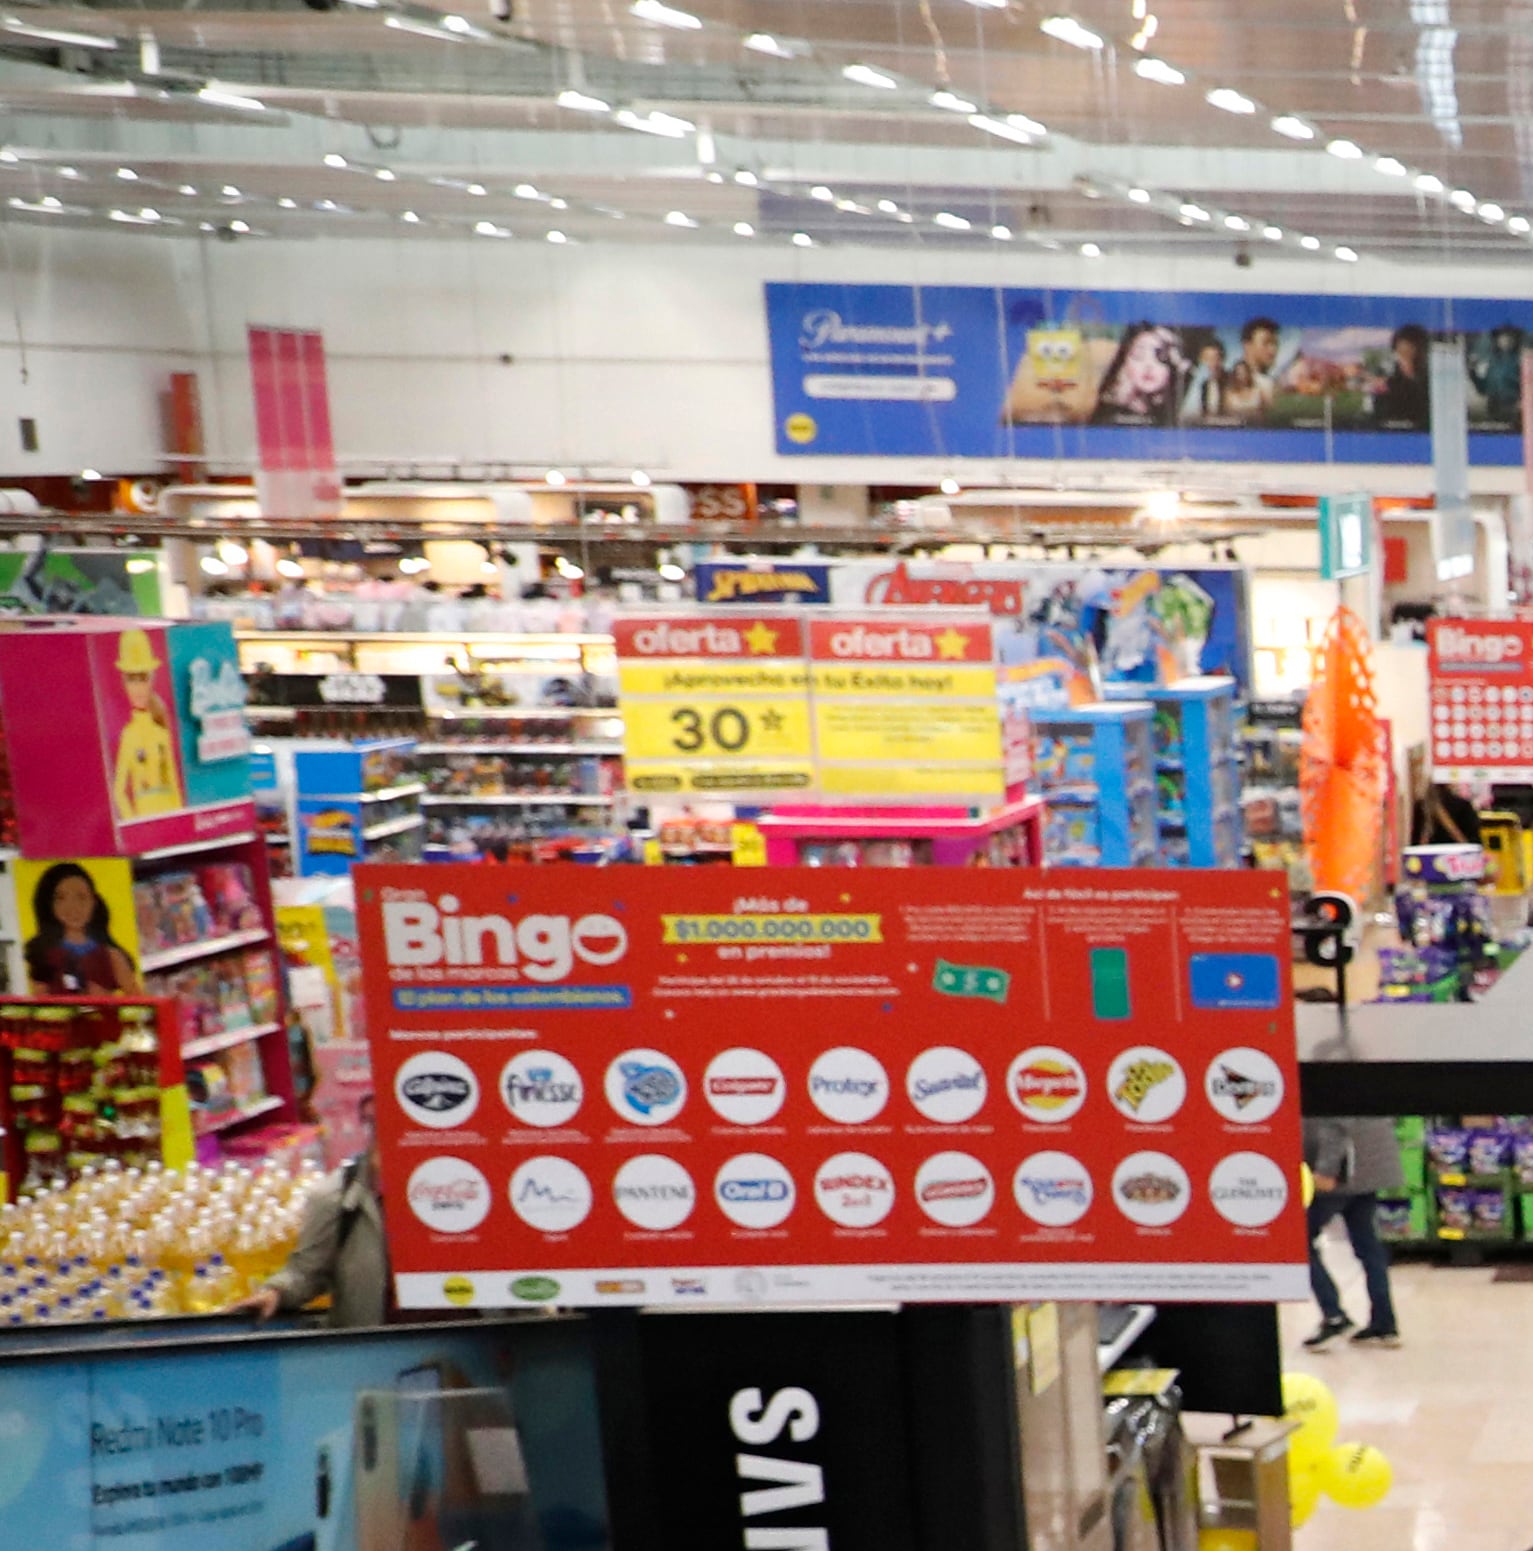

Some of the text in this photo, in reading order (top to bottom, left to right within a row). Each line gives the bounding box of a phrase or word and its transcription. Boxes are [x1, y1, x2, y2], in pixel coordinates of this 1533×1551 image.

[632, 624, 742, 654] oferta
[831, 627, 933, 658] oferta
[1434, 625, 1522, 662] Bingo
[671, 707, 751, 753] 30
[381, 893, 629, 983] Bingo
[675, 919, 871, 940] $1.000.000.000
